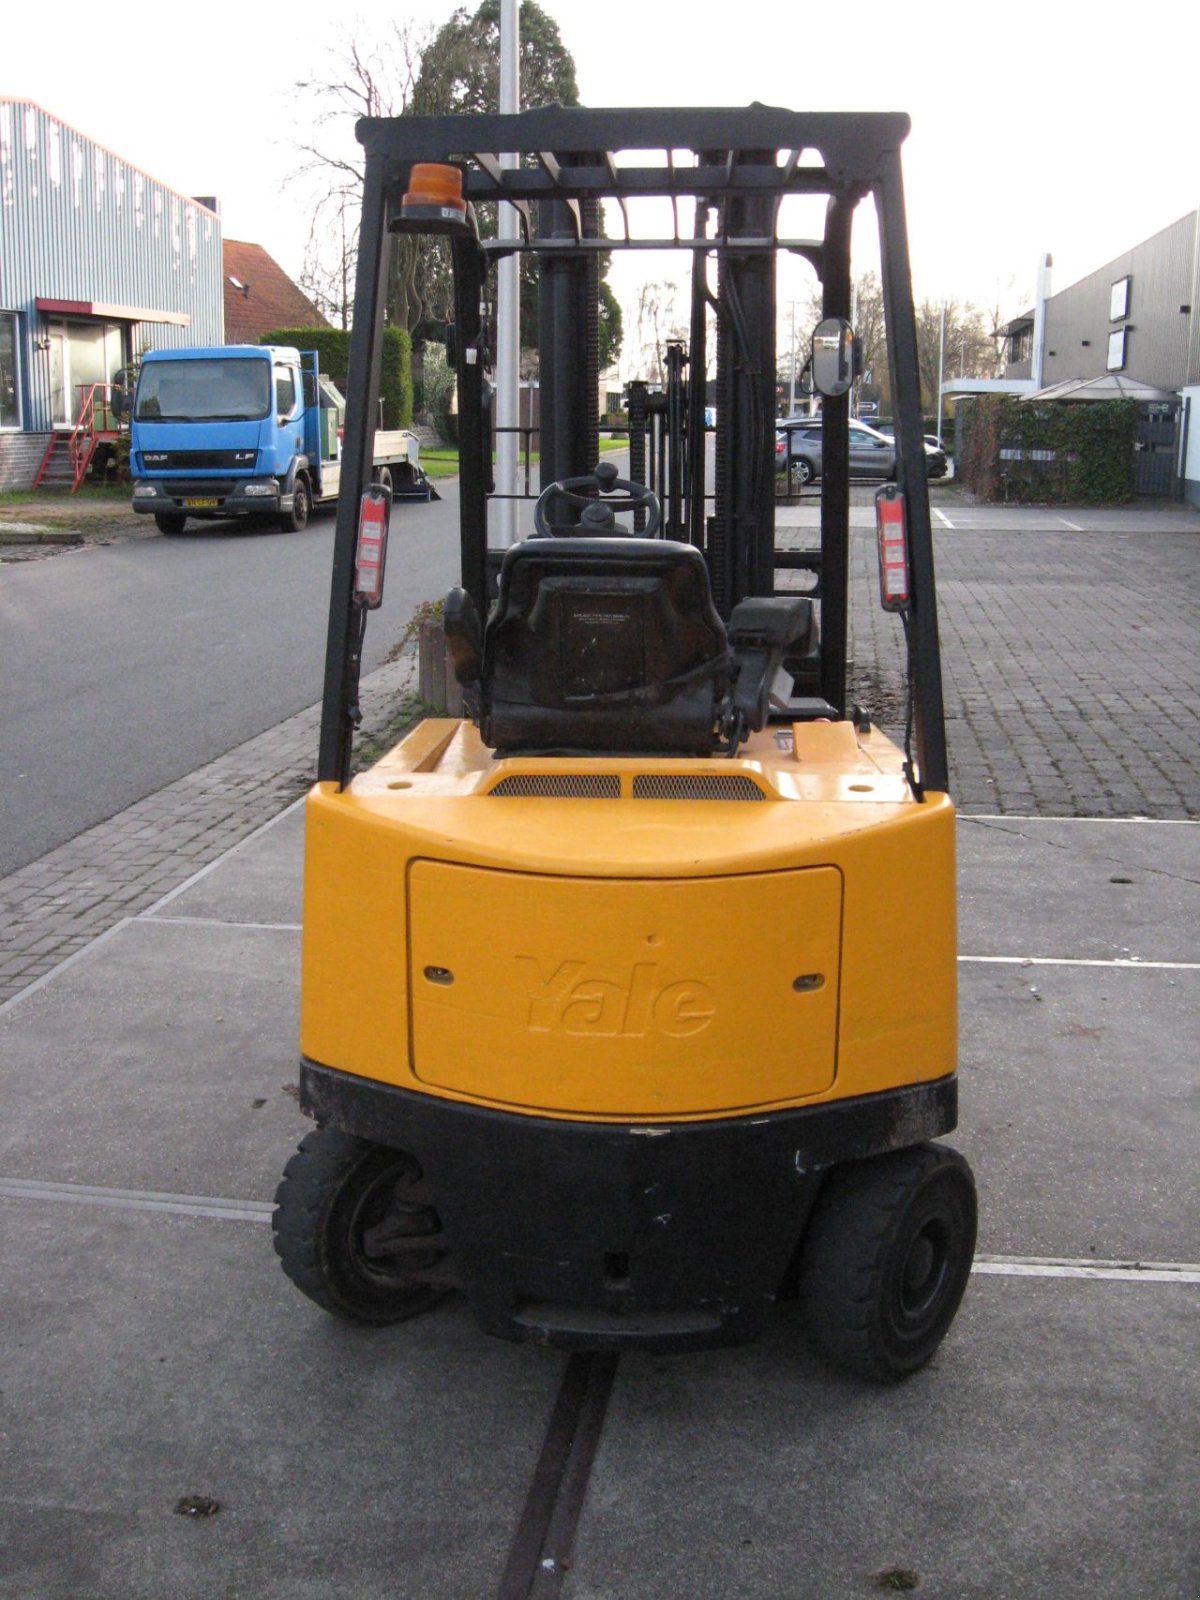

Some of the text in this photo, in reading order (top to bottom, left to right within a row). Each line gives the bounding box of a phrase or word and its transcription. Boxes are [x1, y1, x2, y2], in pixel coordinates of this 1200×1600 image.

[144, 453, 255, 462] DAF LF
[516, 956, 716, 1039] Yale
